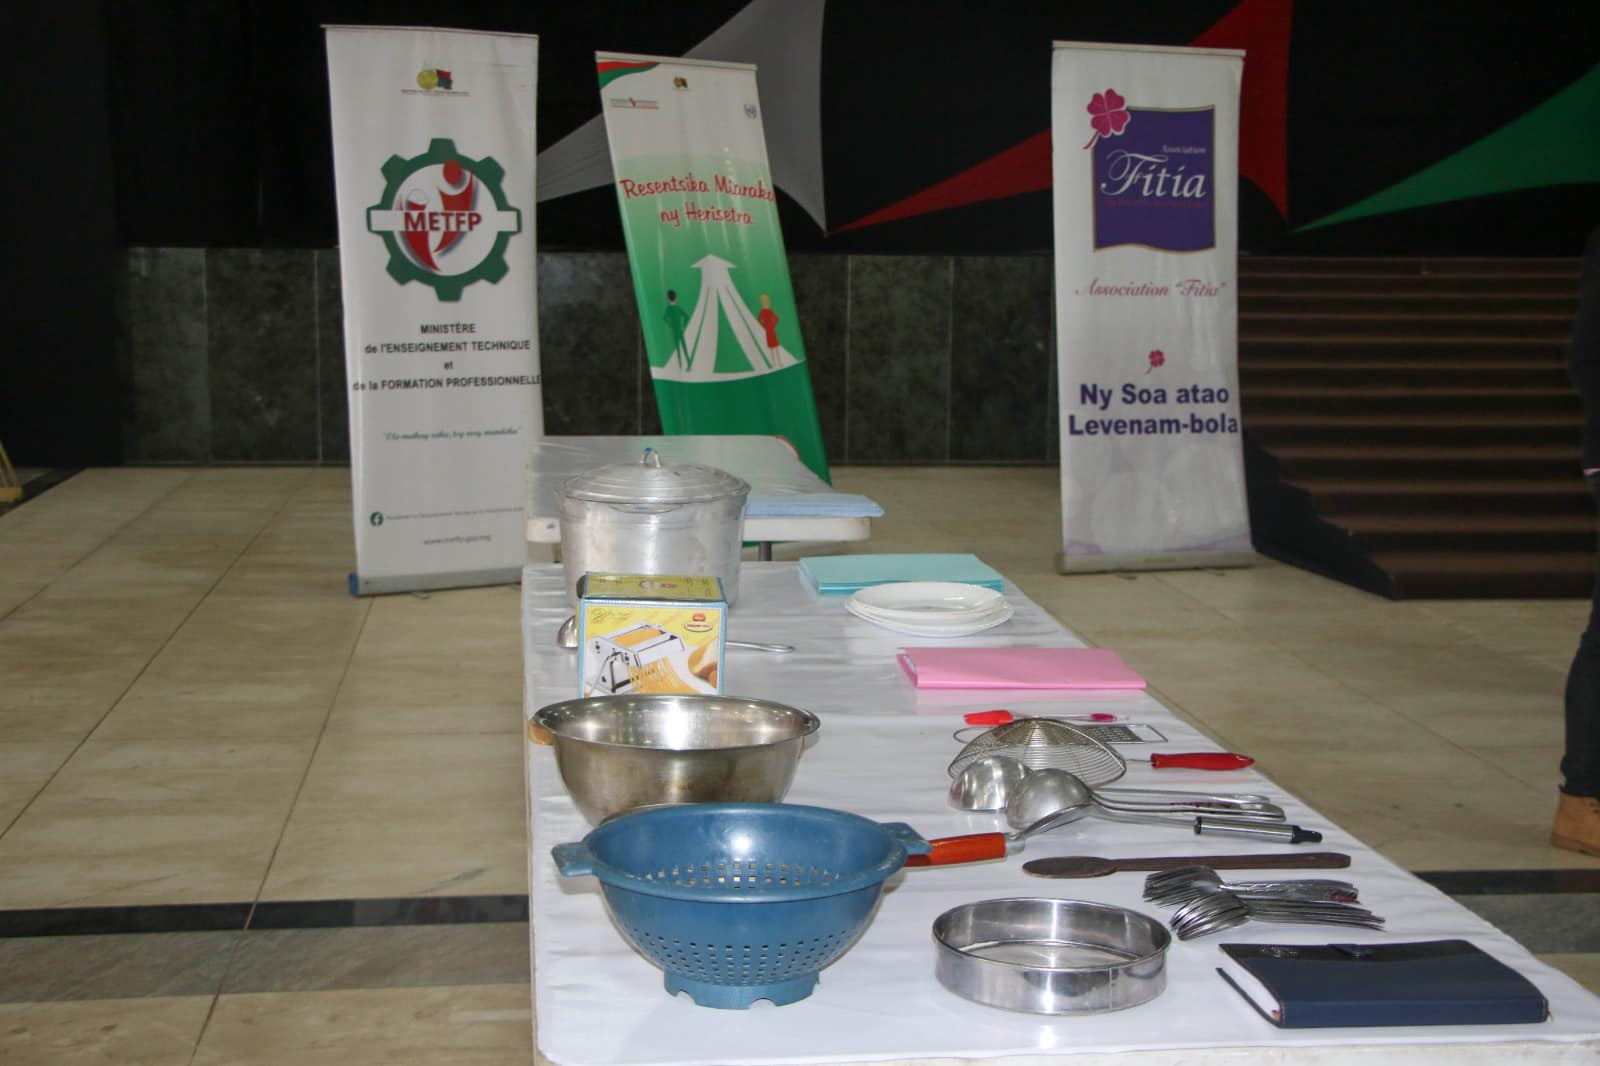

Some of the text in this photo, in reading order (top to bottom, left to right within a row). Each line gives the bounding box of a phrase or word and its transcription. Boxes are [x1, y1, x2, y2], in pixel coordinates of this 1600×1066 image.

[619, 173, 709, 200] Resentsika
[403, 211, 482, 232] METFP
[660, 202, 753, 228] ny Herisetra
[1075, 276, 1169, 296] Association
[365, 344, 377, 354] de
[471, 340, 531, 351] TECHNIQUE
[443, 360, 454, 370] et
[353, 381, 366, 391] de
[369, 380, 378, 390] la
[381, 378, 442, 390] FORMATION
[1080, 383, 1229, 410] Ny Soa atao
[1069, 413, 1239, 436] Levenam-bola
